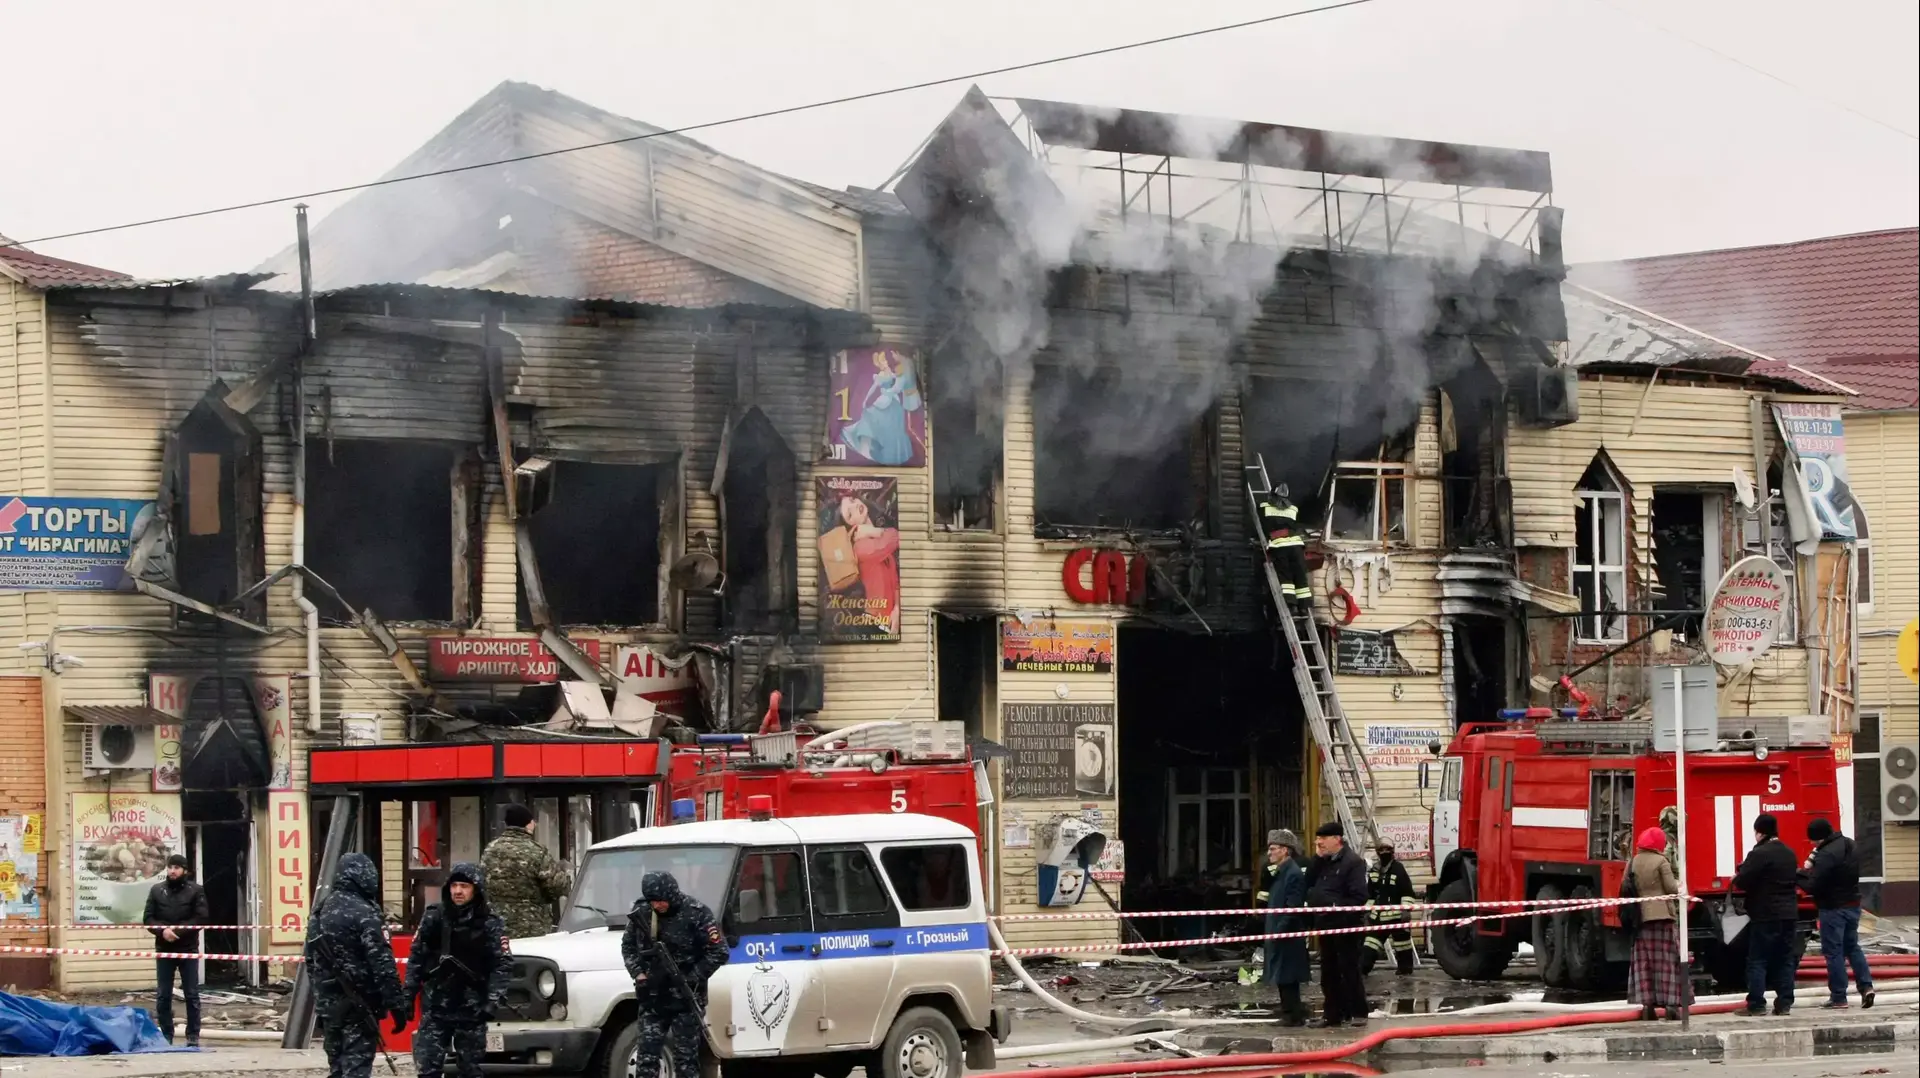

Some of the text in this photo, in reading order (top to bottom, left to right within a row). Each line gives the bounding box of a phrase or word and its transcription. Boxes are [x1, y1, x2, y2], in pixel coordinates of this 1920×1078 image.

[835, 386, 852, 421] 1
[1793, 420, 1833, 434] 892-17-92
[26, 507, 126, 533] ТОРТЫ
[827, 594, 888, 609] Женская
[833, 612, 891, 627] Одежда
[440, 642, 533, 659] ПИРОЖНОЕ,
[457, 661, 561, 676] АРИШТА-ХАЛ
[1016, 662, 1095, 672] ЛЕЧЕБНЫЕ ТРАВЫ
[1005, 706, 1113, 722] РЕМОНТ И УСТАНОВКА
[1010, 723, 1069, 735] АВТОМАТИЧЕСКИХ
[1050, 738, 1075, 750] МАШИН
[1020, 751, 1059, 764] ВСЕХ ВИДОВ
[1767, 774, 1782, 794] 5
[890, 789, 908, 813] 5
[1762, 803, 1796, 812] Грозный
[110, 810, 146, 823] КАФЕ
[1394, 832, 1421, 843] ОБУВИ
[278, 801, 303, 932] ПИЦЦА
[819, 934, 870, 951] ПОЛИЦИЯ
[906, 930, 969, 946] г. Грозный
[745, 941, 776, 957] ОП-1
